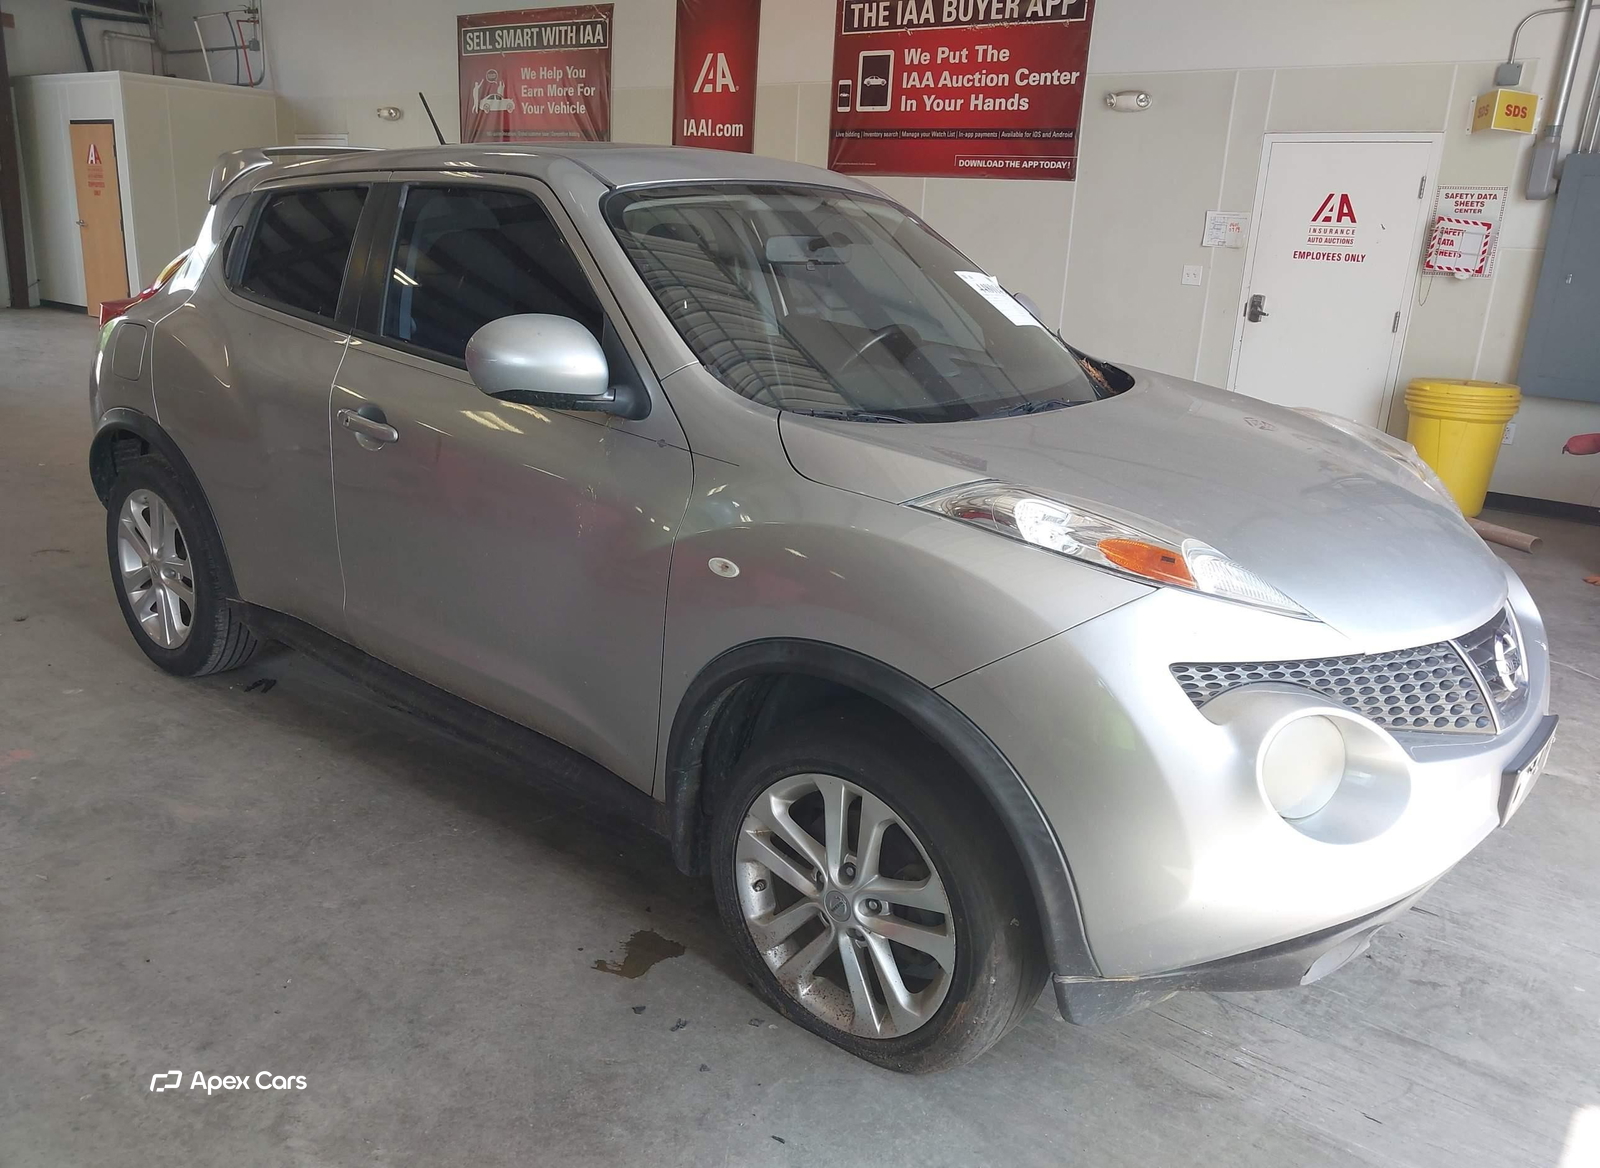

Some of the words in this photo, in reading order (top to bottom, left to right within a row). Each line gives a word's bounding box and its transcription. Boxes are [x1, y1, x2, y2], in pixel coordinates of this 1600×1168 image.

[850, 3, 890, 28] THE
[896, 0, 936, 26] IAA
[942, 0, 1020, 23] BUYER
[1026, 0, 1076, 17] APP
[466, 31, 493, 51] SELL
[495, 27, 540, 48] SMART
[541, 24, 577, 46] WITH
[579, 23, 604, 44] IAA
[903, 48, 931, 65] We
[936, 46, 969, 64] Put
[974, 44, 1010, 63] The
[521, 67, 537, 80] We
[539, 66, 563, 81] Help
[566, 65, 586, 79] You
[902, 71, 935, 89] IAA
[937, 69, 1009, 88] Auction
[1014, 67, 1080, 87] Center
[521, 84, 544, 97] Earn
[547, 84, 575, 97] More
[577, 83, 596, 97] For
[521, 102, 545, 115] Your
[547, 101, 586, 114] Vehicle
[900, 95, 917, 112] In
[922, 94, 964, 112] Your
[969, 93, 1030, 111] Hands
[1504, 103, 1528, 119] SDS
[683, 118, 744, 137] IAAI.com
[863, 130, 883, 139] Inventory
[901, 131, 920, 139] Manage
[947, 130, 956, 138] List
[958, 131, 974, 139] In-app
[974, 131, 998, 139] payments
[958, 160, 1004, 168] DOWNLOAD
[1005, 160, 1020, 168] THE
[1444, 192, 1475, 200] SAFETY
[1454, 200, 1485, 208] SHEETS
[1293, 250, 1342, 262] EMPLOYEES
[1344, 253, 1366, 262] ONLY
